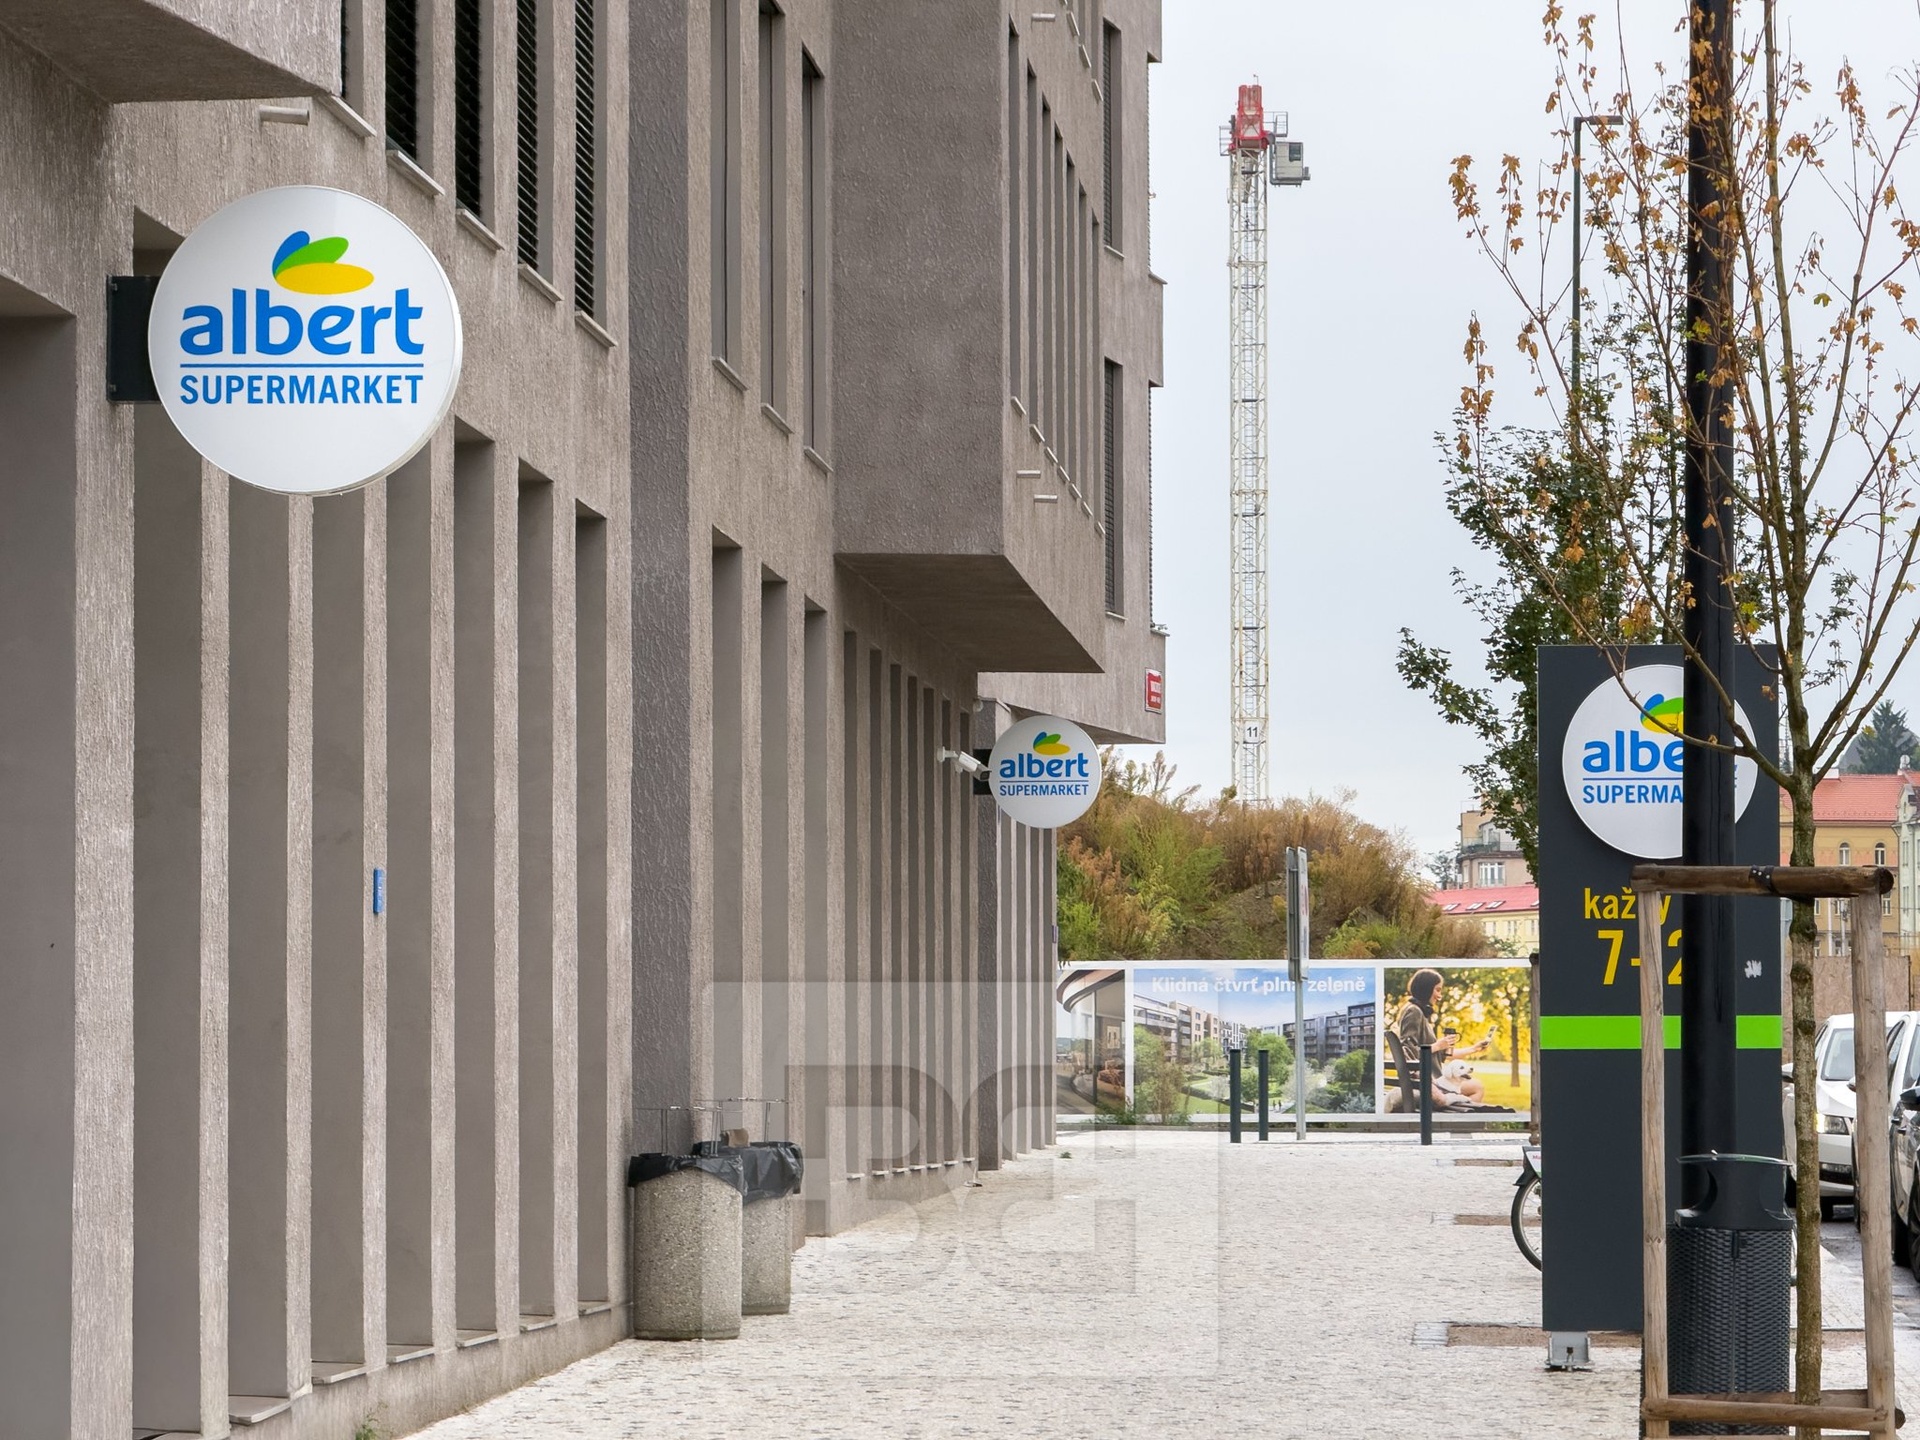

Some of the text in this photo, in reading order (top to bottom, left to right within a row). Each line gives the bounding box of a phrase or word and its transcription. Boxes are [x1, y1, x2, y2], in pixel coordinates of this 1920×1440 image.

[180, 288, 424, 355] albert
[180, 375, 423, 404] SUPERMARKET
[1246, 726, 1258, 738] 11
[1582, 730, 1738, 773] albe
[1000, 752, 1089, 778] albert
[1000, 784, 1089, 796] SUPERMARKET
[1582, 785, 1738, 804] SUPERMA
[1584, 886, 1671, 925] kažy
[1152, 976, 1209, 992] Klidná
[1214, 976, 1258, 992] čtvrť
[1307, 976, 1366, 992] zeleně
